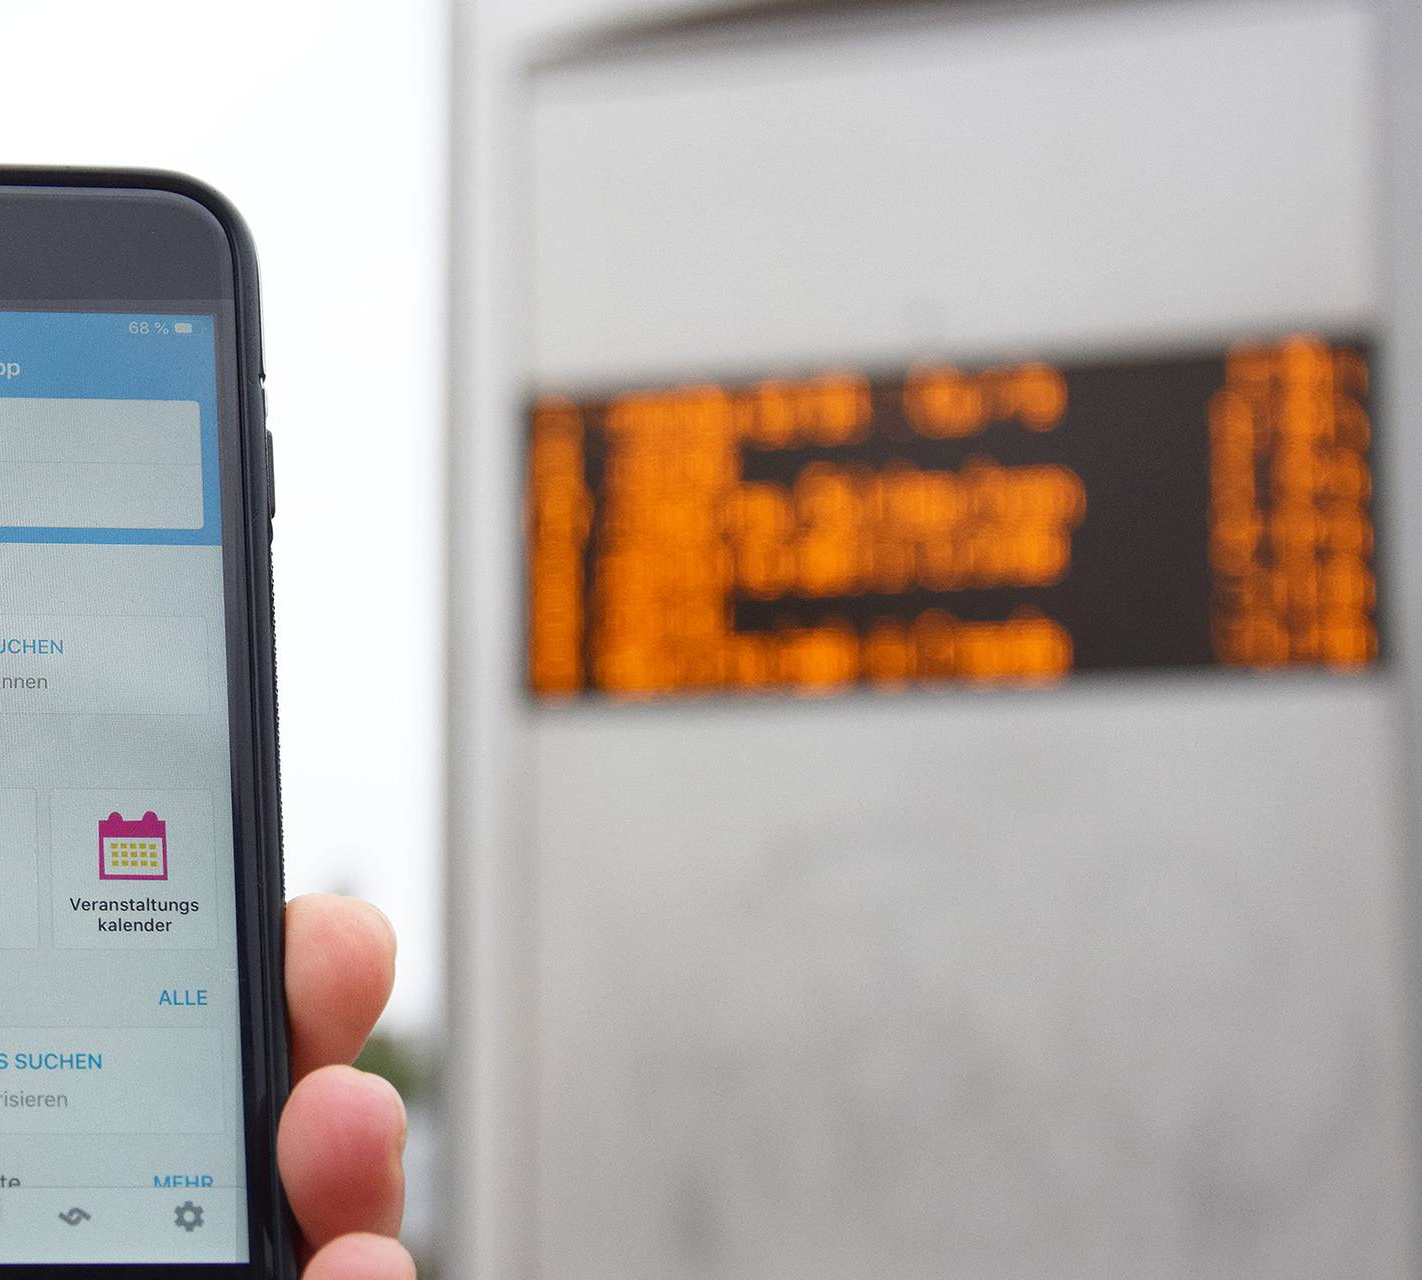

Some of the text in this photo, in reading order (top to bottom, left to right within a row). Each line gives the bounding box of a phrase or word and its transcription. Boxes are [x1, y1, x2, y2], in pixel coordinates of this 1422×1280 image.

[129, 322, 170, 334] 68 %
[69, 897, 199, 917] Veranstaltungs
[97, 917, 172, 933] kalender
[159, 990, 207, 1006] ALLE
[14, 1053, 103, 1070] SUCHEN
[153, 1174, 214, 1188] MEHR
